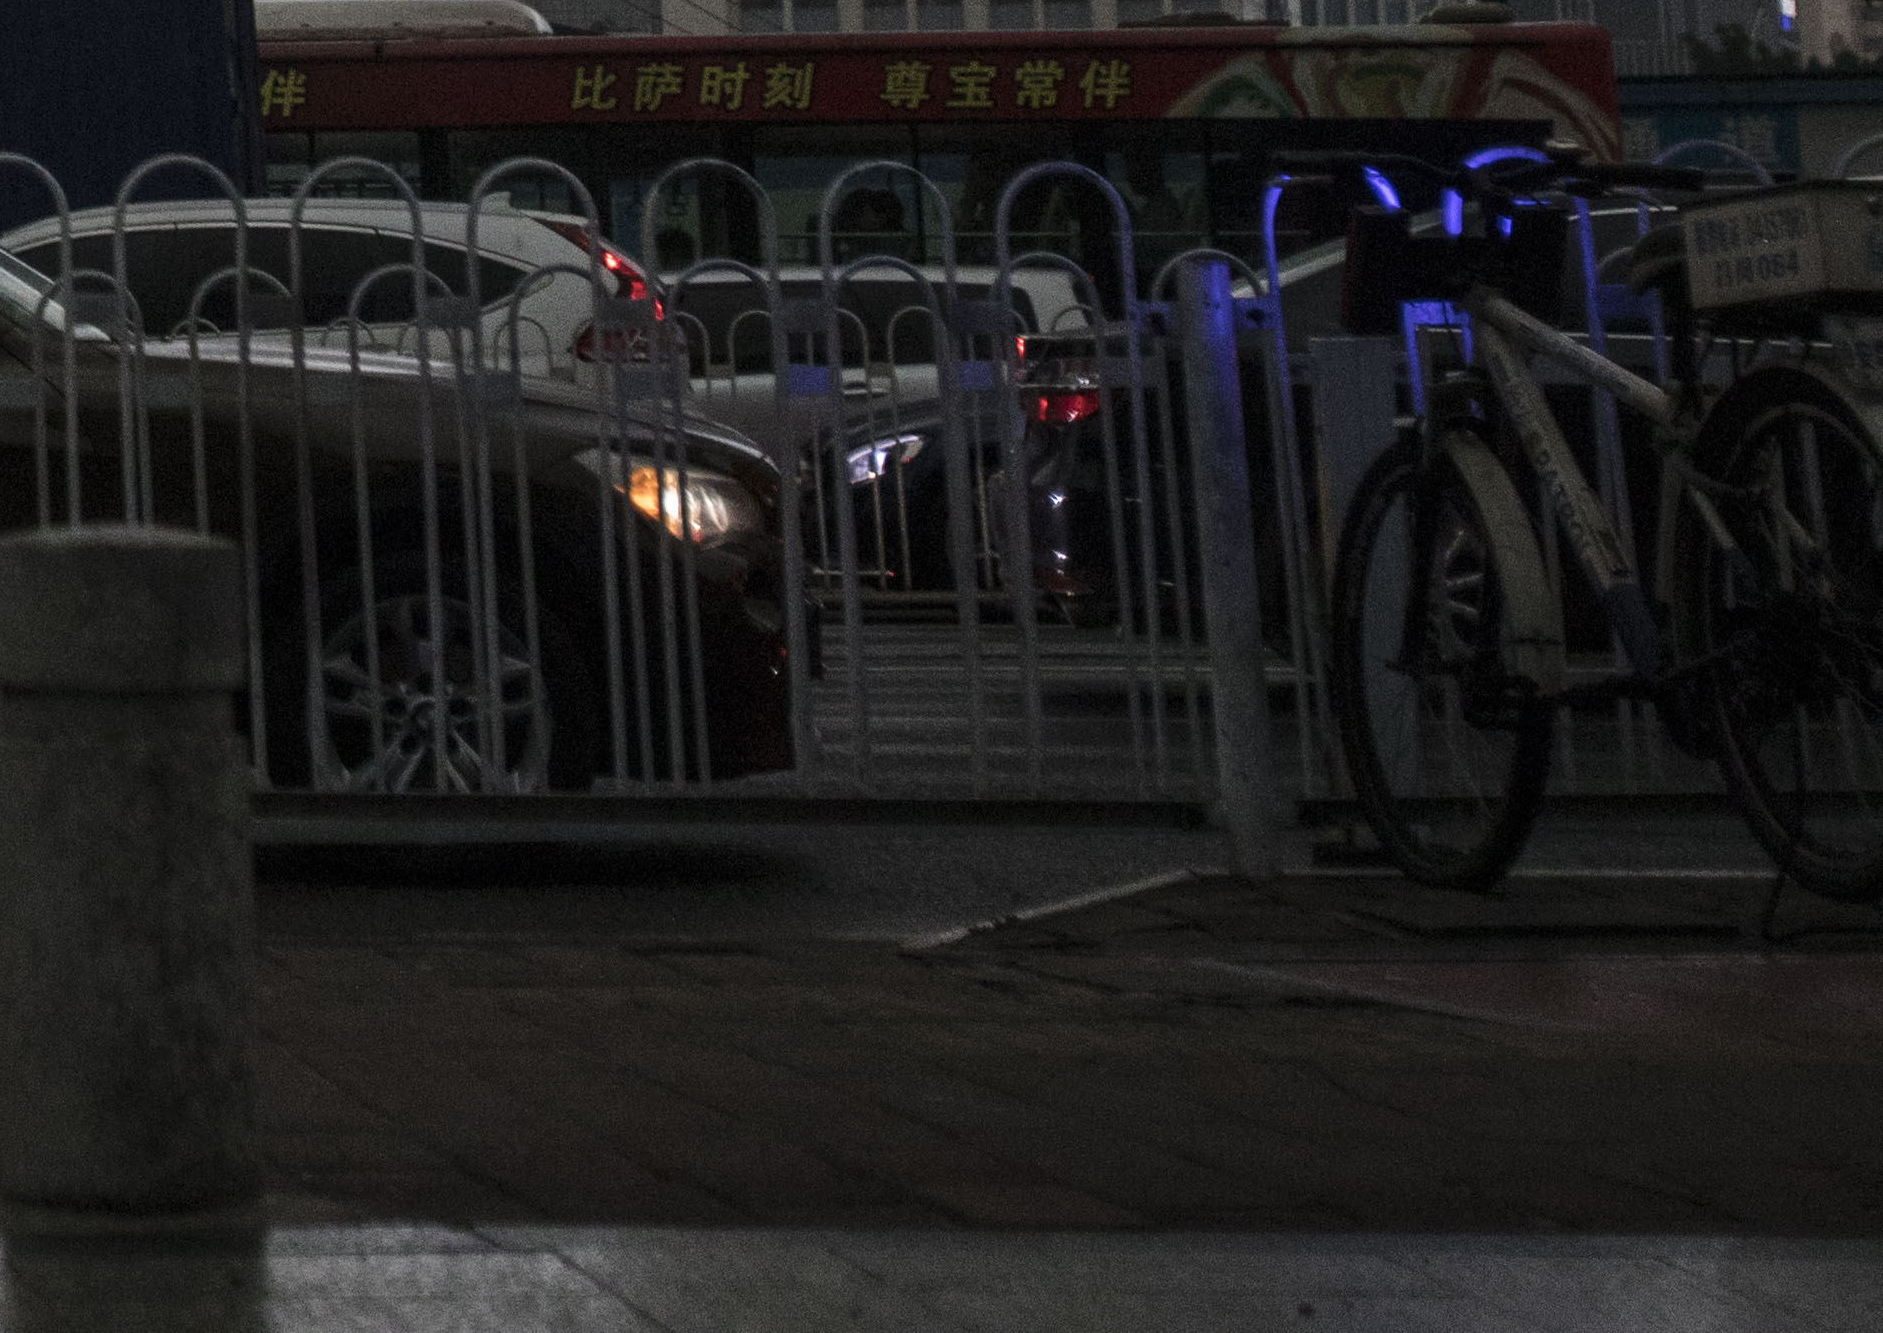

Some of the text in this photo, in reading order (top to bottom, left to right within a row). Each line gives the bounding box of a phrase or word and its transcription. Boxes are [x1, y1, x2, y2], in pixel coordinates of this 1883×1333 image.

[259, 67, 308, 117] 伴
[569, 58, 1131, 111] 比萨时刻 尊宝常伴
